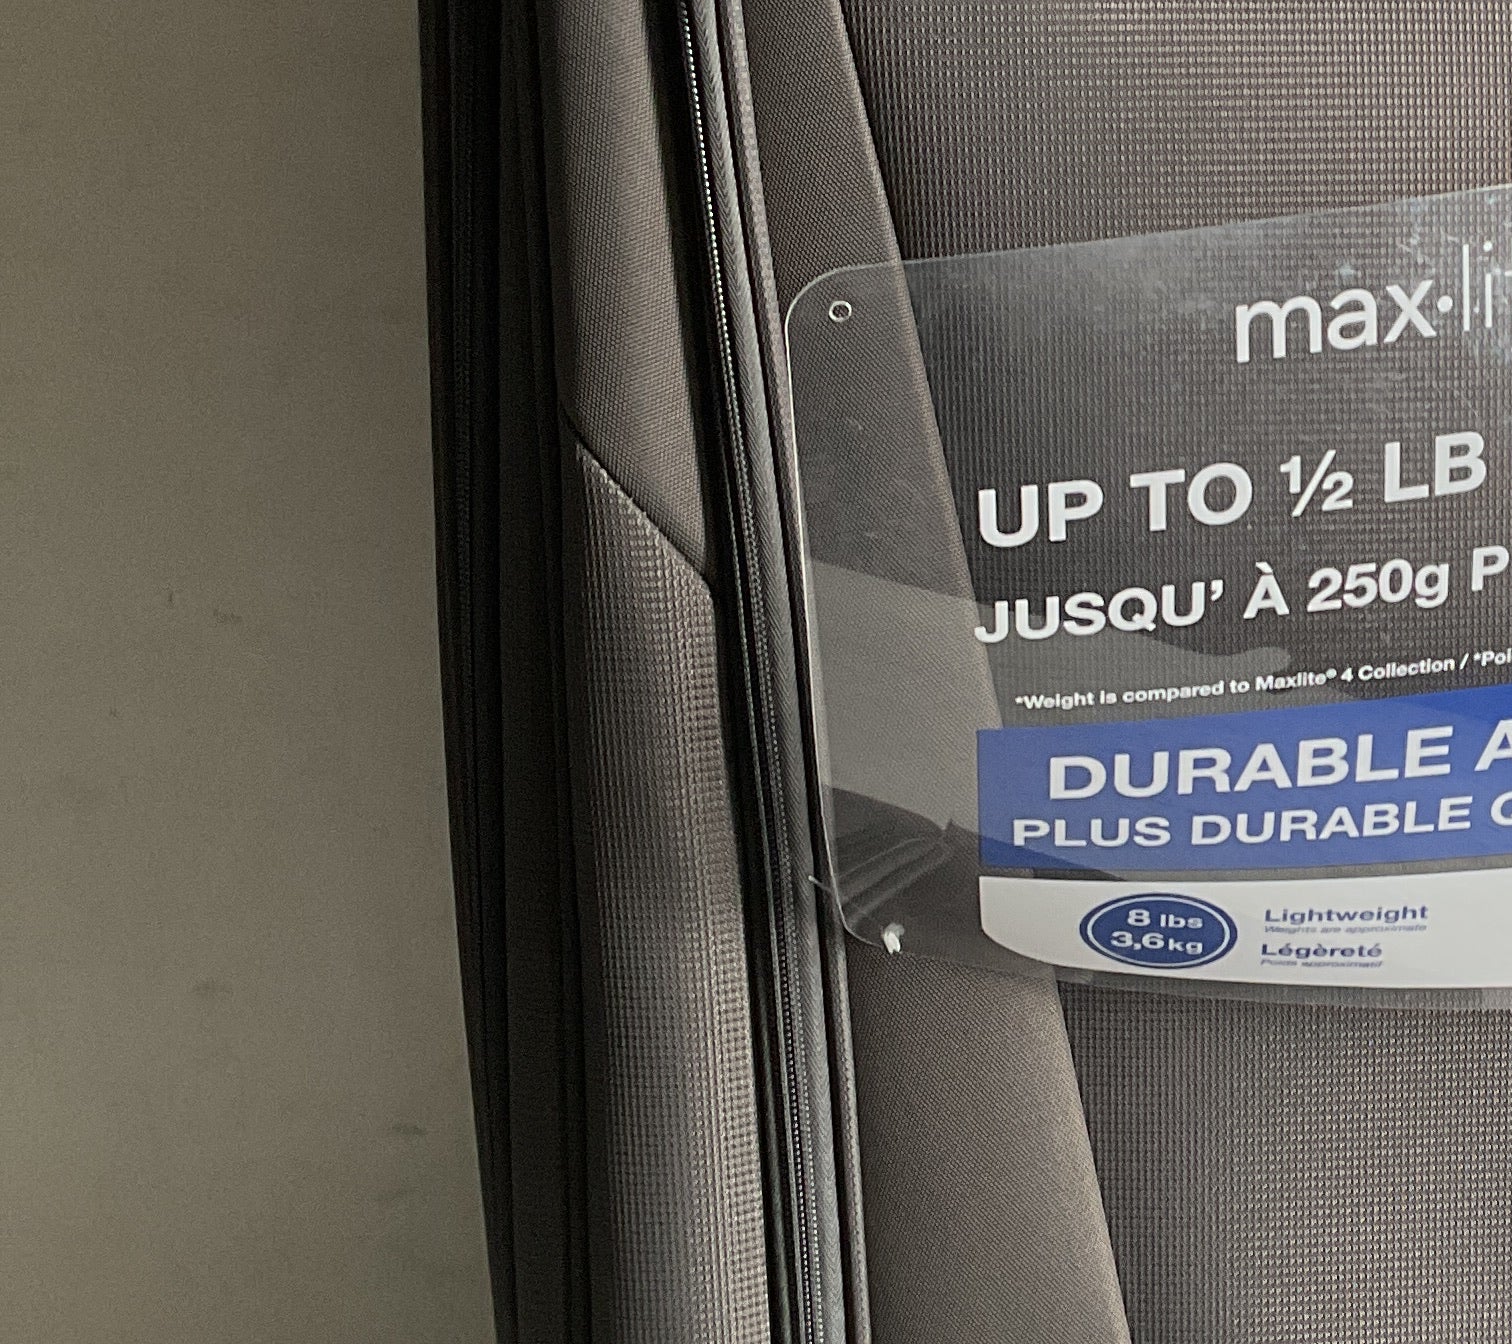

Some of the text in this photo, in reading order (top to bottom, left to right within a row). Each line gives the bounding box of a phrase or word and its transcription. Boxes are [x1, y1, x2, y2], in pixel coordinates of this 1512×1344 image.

[978, 479, 1103, 547] UP
[1130, 462, 1253, 532] TO
[1385, 431, 1487, 503] LB
[1243, 562, 1290, 620] À
[1307, 559, 1449, 613] 250g
[1100, 690, 1117, 705] is
[1122, 680, 1224, 703] compared
[1229, 679, 1250, 694] to
[1340, 667, 1353, 682] 4
[1357, 657, 1456, 681] Collection
[1050, 725, 1453, 800] DURABLE
[1013, 816, 1171, 847] PLUS
[1191, 796, 1473, 846] DURABLE
[1127, 909, 1203, 928] 8 lbs
[1265, 906, 1428, 925] Lightweight
[1261, 942, 1382, 959] Légèreté
